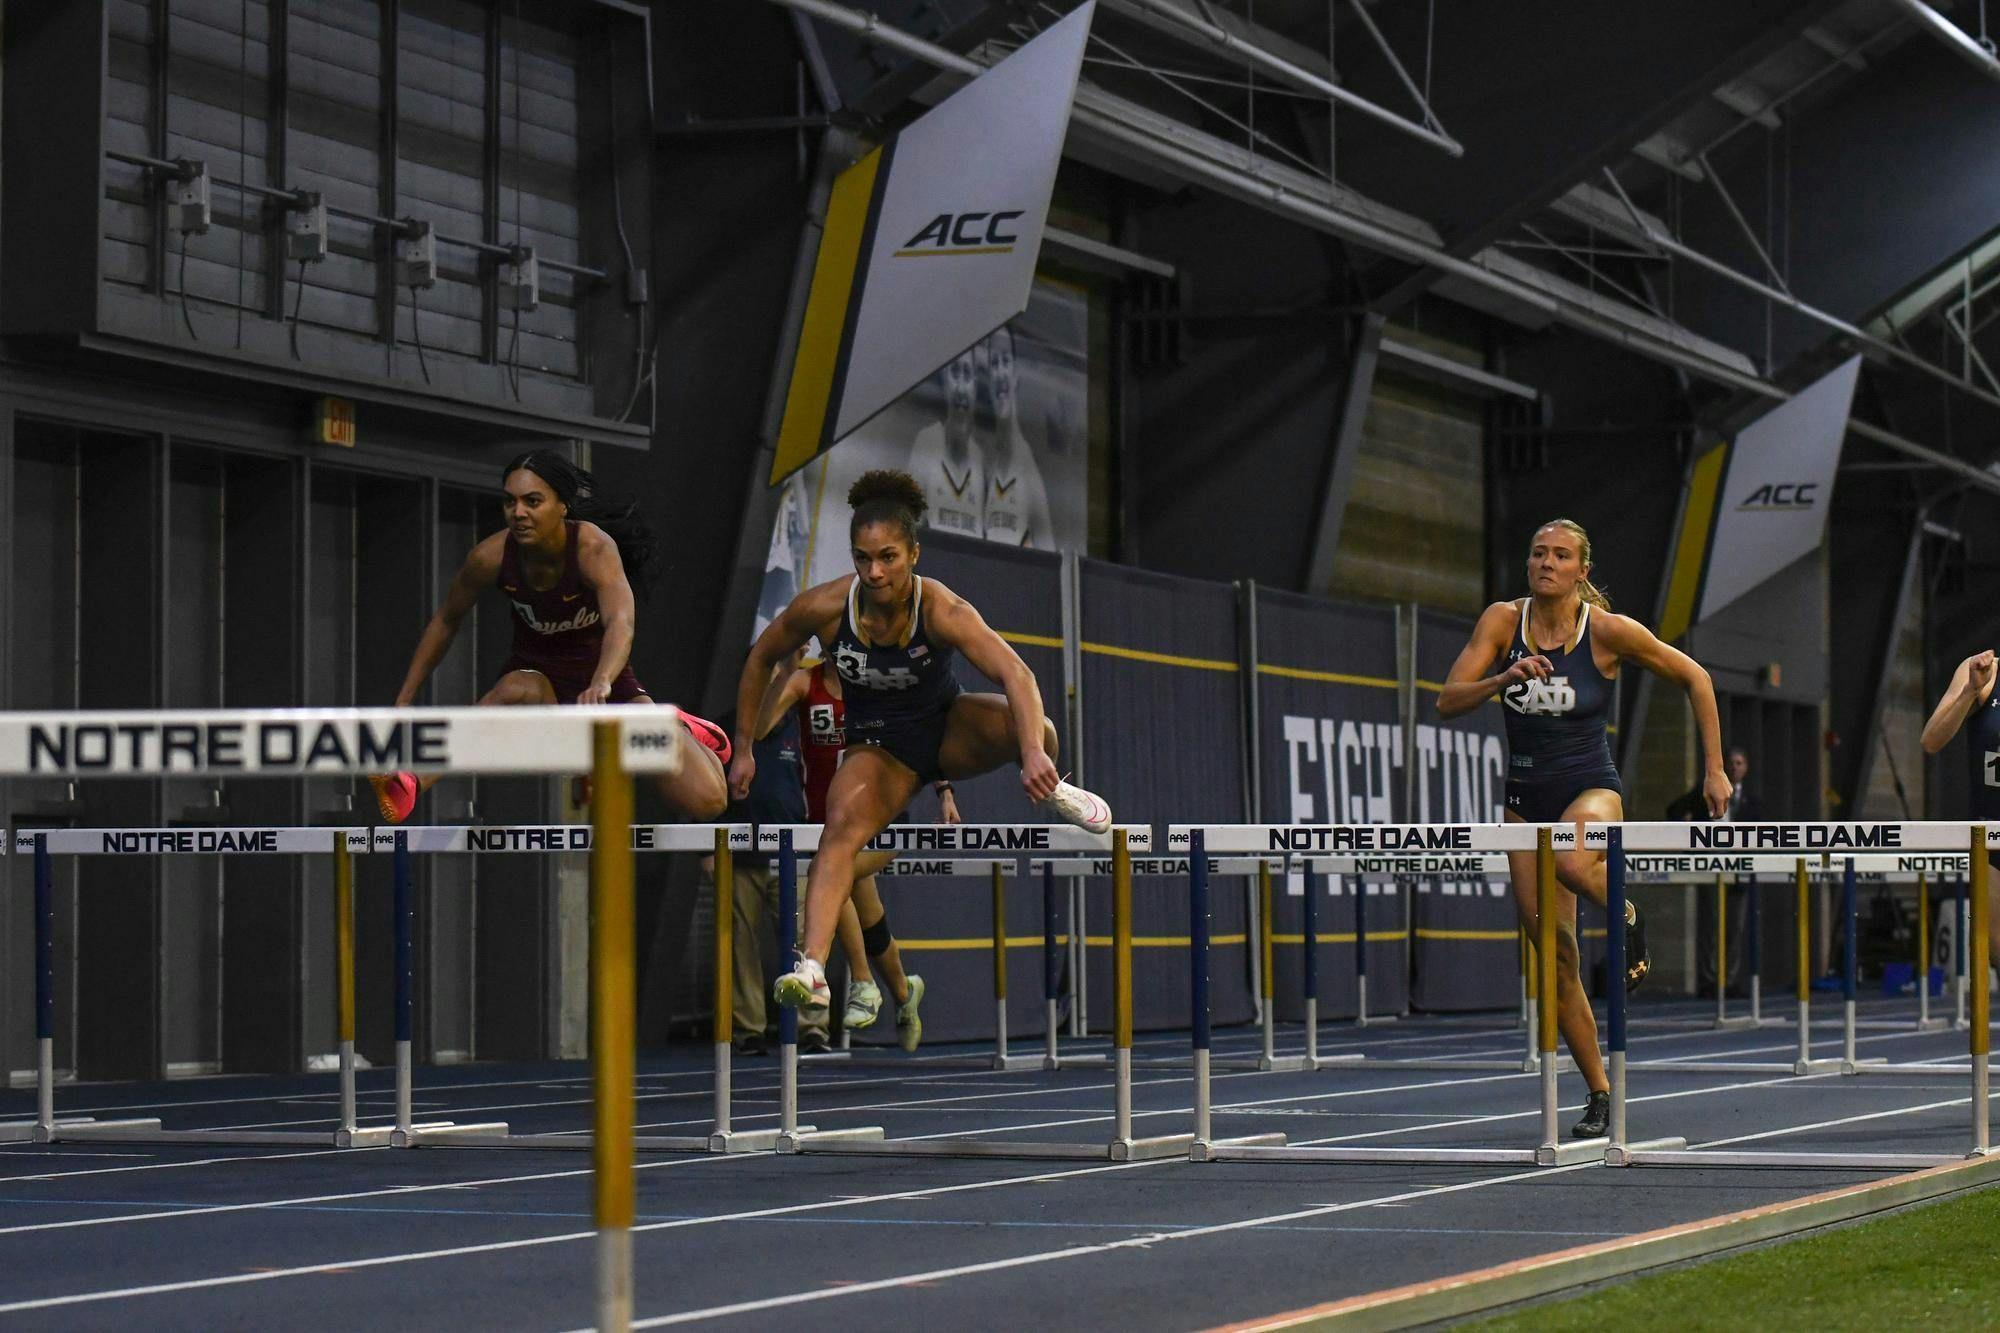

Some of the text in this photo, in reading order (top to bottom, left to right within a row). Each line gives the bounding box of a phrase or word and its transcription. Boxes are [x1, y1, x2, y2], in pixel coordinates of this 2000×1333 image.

[903, 210, 1026, 248] ACC
[1742, 484, 1818, 505] ACC
[512, 599, 600, 635] Loyola
[839, 655, 860, 680] 3
[1507, 681, 1529, 708] 2
[813, 710, 831, 730] 5
[28, 720, 451, 770] NOTRE DAME
[1283, 716, 1506, 896] FIGHTING
[103, 831, 278, 853] NOTRE DAME
[467, 828, 654, 850] NOTRE DE
[962, 828, 1050, 849] DAME
[1269, 827, 1472, 850] NOTRE DAME
[1690, 825, 1902, 848] NOTRE DAME
[898, 861, 953, 875] DAME
[1162, 860, 1219, 874] DAE
[1354, 857, 1483, 872] NOTRE DAME
[1625, 857, 1754, 872] NOTRE DAME
[1898, 856, 1969, 871] NOTRE
[1392, 872, 1487, 884] NOTRE DAME
[1938, 926, 1951, 963] 6
